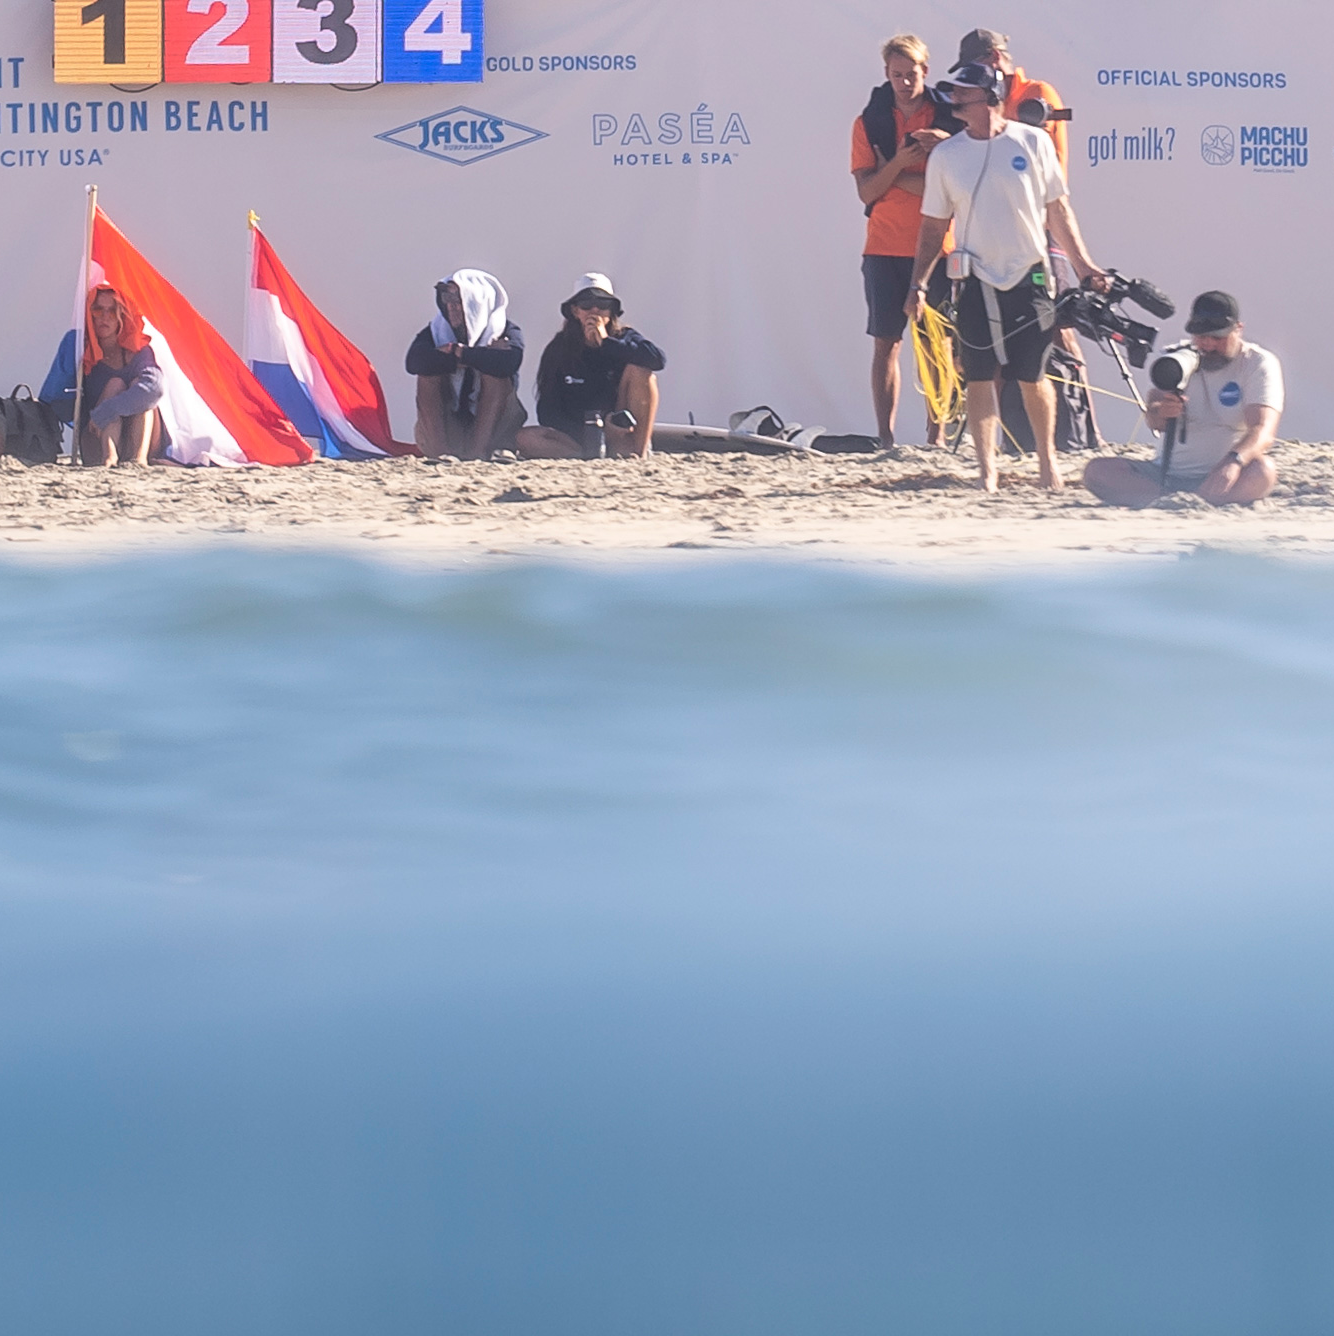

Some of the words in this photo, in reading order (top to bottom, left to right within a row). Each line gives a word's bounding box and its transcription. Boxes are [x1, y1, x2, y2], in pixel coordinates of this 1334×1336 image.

[485, 56, 535, 73] GOLD
[538, 55, 637, 72] SPONSORS
[1097, 69, 1182, 87] OFFICIAL
[1186, 70, 1287, 89] SPONSORS
[166, 100, 269, 133] BEACH
[592, 103, 751, 146] PASÉA
[1240, 125, 1308, 146] MACHU
[1088, 127, 1117, 168] got
[1123, 126, 1176, 162] milk?
[1240, 147, 1308, 168] PICCHU
[0, 148, 49, 168] CITY
[613, 152, 673, 166] HOTEL
[681, 152, 692, 165] &
